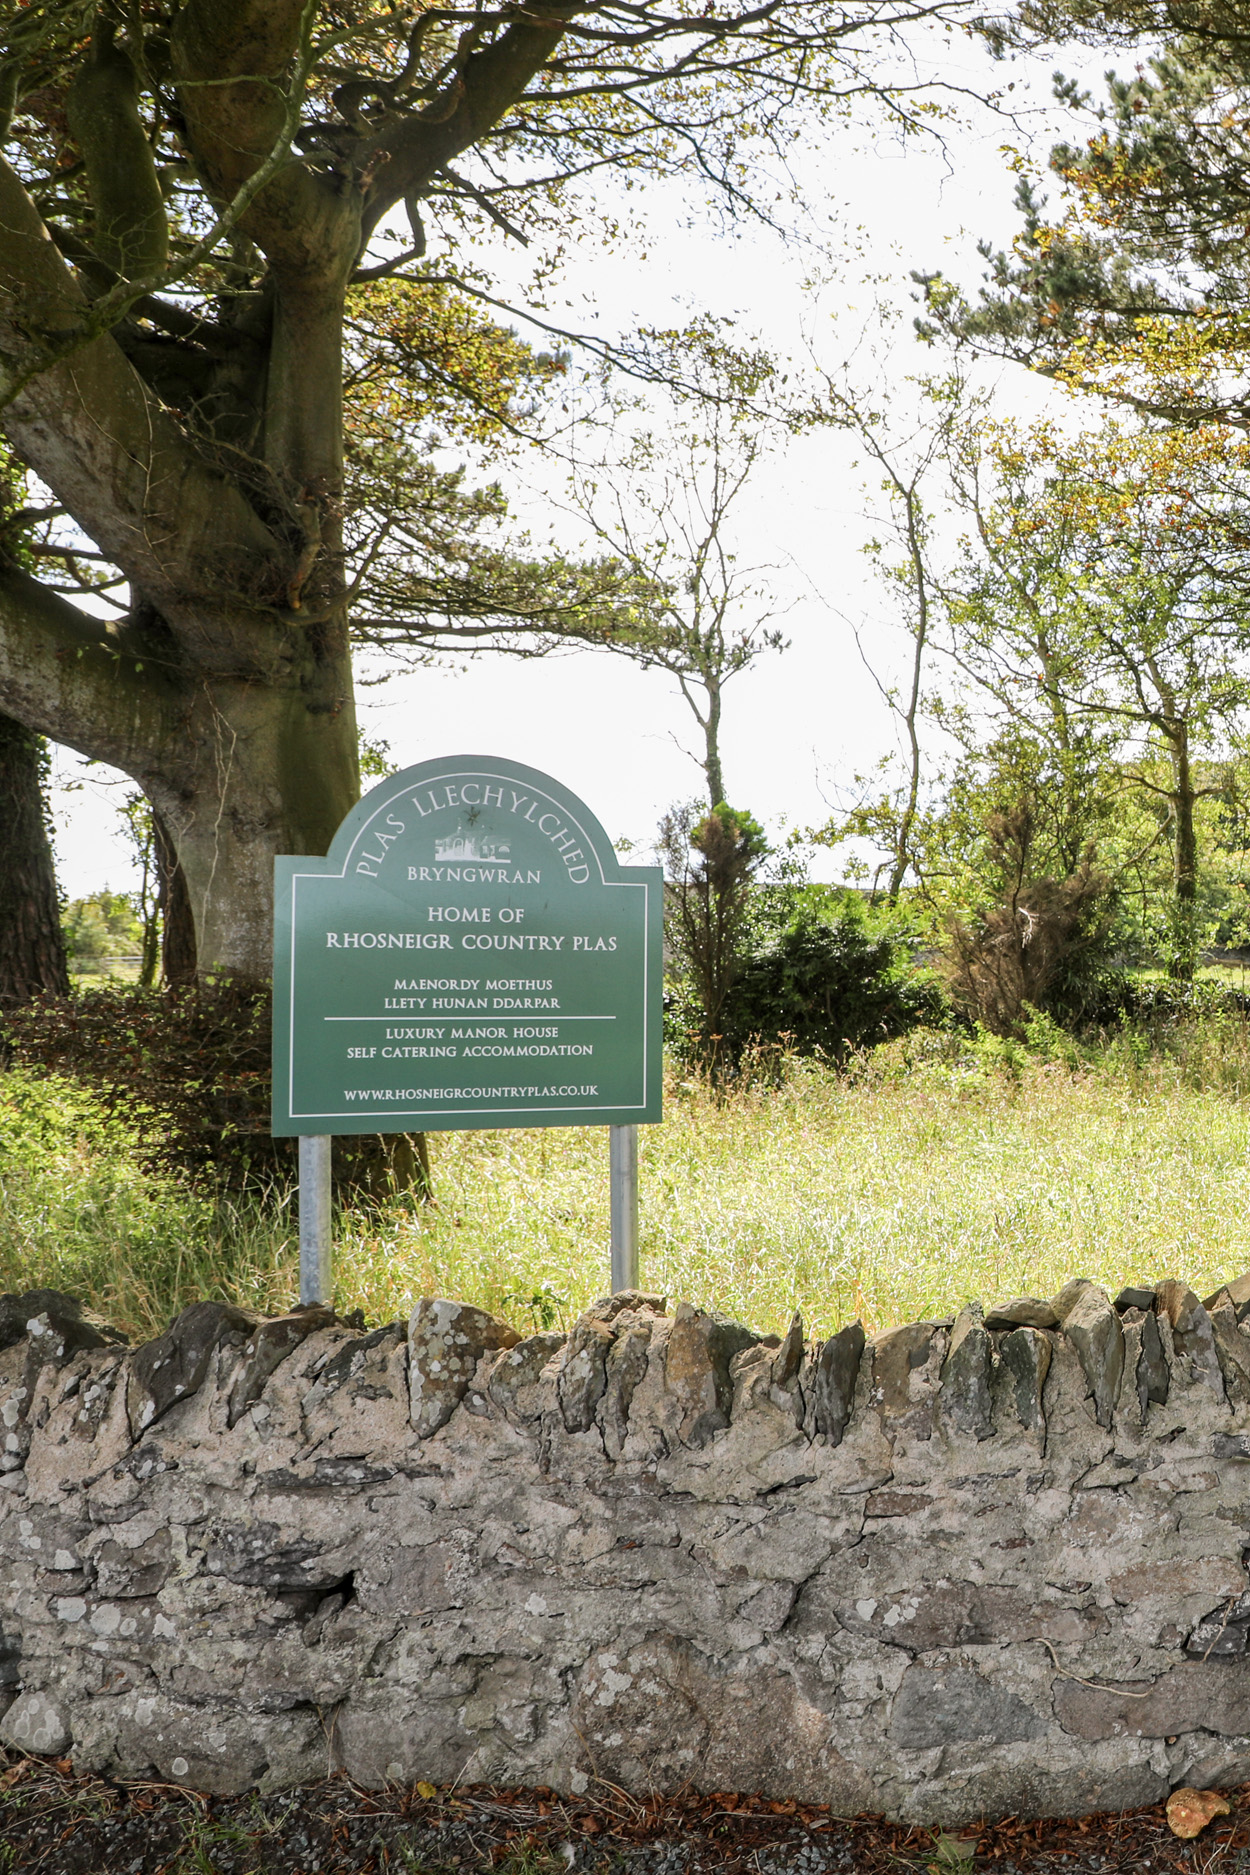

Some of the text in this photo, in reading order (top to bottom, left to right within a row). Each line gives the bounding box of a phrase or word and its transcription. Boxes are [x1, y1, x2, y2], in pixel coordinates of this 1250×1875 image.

[355, 784, 589, 884] PLAS LLECHYLCHED
[408, 866, 541, 884] BRYNGWRAN
[428, 907, 524, 923] HOME OF
[326, 933, 617, 951] RHOSNEIGR COUNTRY PLAS
[394, 979, 552, 991] MAENORDY MOETHUS
[384, 997, 560, 1009] LLETY HUNAN DDARPAR
[386, 1027, 558, 1039] LUXURY MANOR HOUSE
[347, 1045, 593, 1059] SELF CATERING ACCOMMODATION
